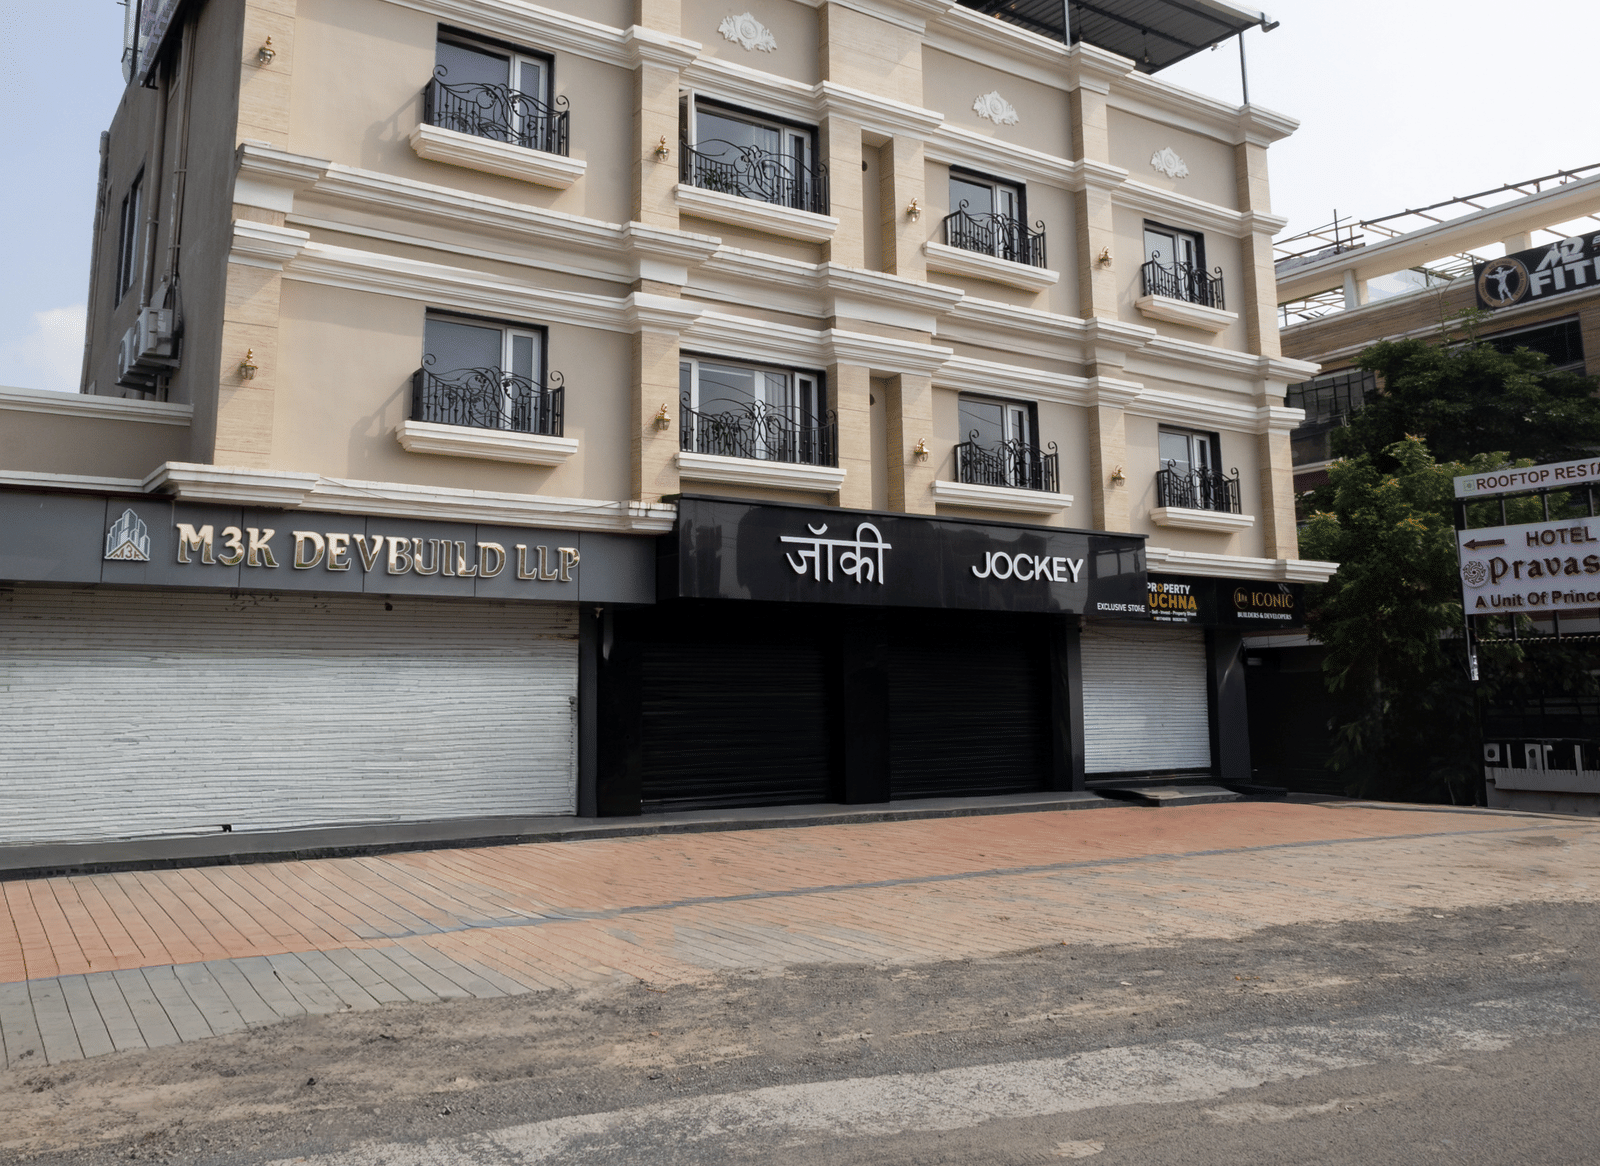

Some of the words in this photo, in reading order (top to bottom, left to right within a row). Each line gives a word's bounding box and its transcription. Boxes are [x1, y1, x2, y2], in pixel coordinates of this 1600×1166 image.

[1476, 469, 1549, 490] ROOFTOP
[1526, 526, 1597, 546] HOTEL
[176, 523, 279, 567] M3K
[292, 530, 506, 578] DEVBUILD
[515, 543, 581, 582] LLP
[780, 522, 892, 585] जॉकी
[971, 551, 1084, 583] JOCKEY
[1147, 582, 1191, 595] PROPERTY
[1096, 602, 1127, 611] EXCLUSIVE
[1127, 604, 1146, 613] STORE
[1252, 591, 1294, 608] ICONIC
[1475, 595, 1487, 609] A
[1490, 594, 1523, 607] Unit
[1527, 591, 1547, 606] Of
[1237, 611, 1260, 619] BUILDERS
[1264, 612, 1293, 620] DEVELOPERS
